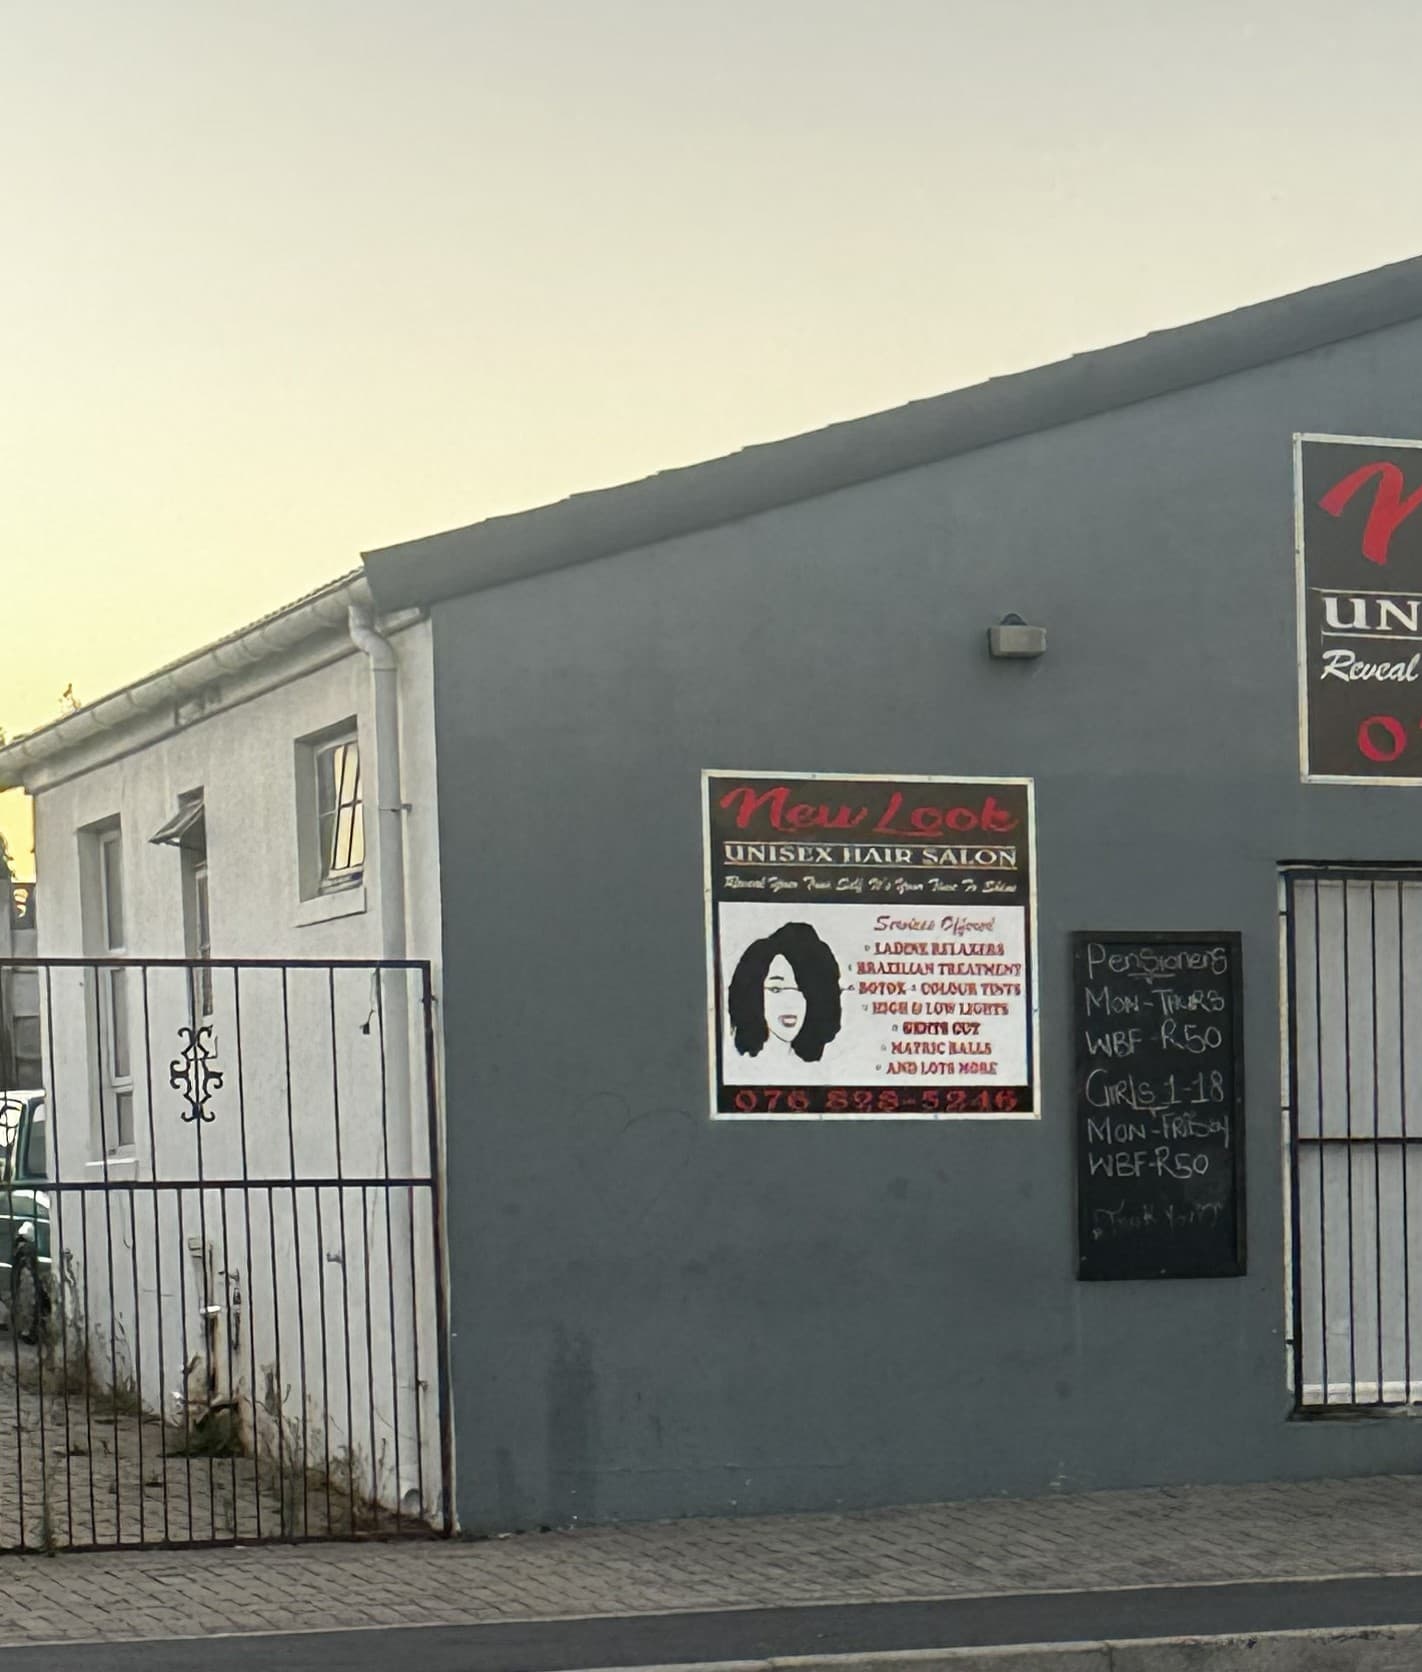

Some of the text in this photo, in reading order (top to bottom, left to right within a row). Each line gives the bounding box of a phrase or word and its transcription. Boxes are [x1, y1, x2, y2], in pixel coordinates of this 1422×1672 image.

[1321, 650, 1420, 683] Reveal
[720, 787, 1019, 838] New Look
[725, 845, 1017, 867] UNISEX HAIR SALON
[735, 1090, 810, 1111] 076
